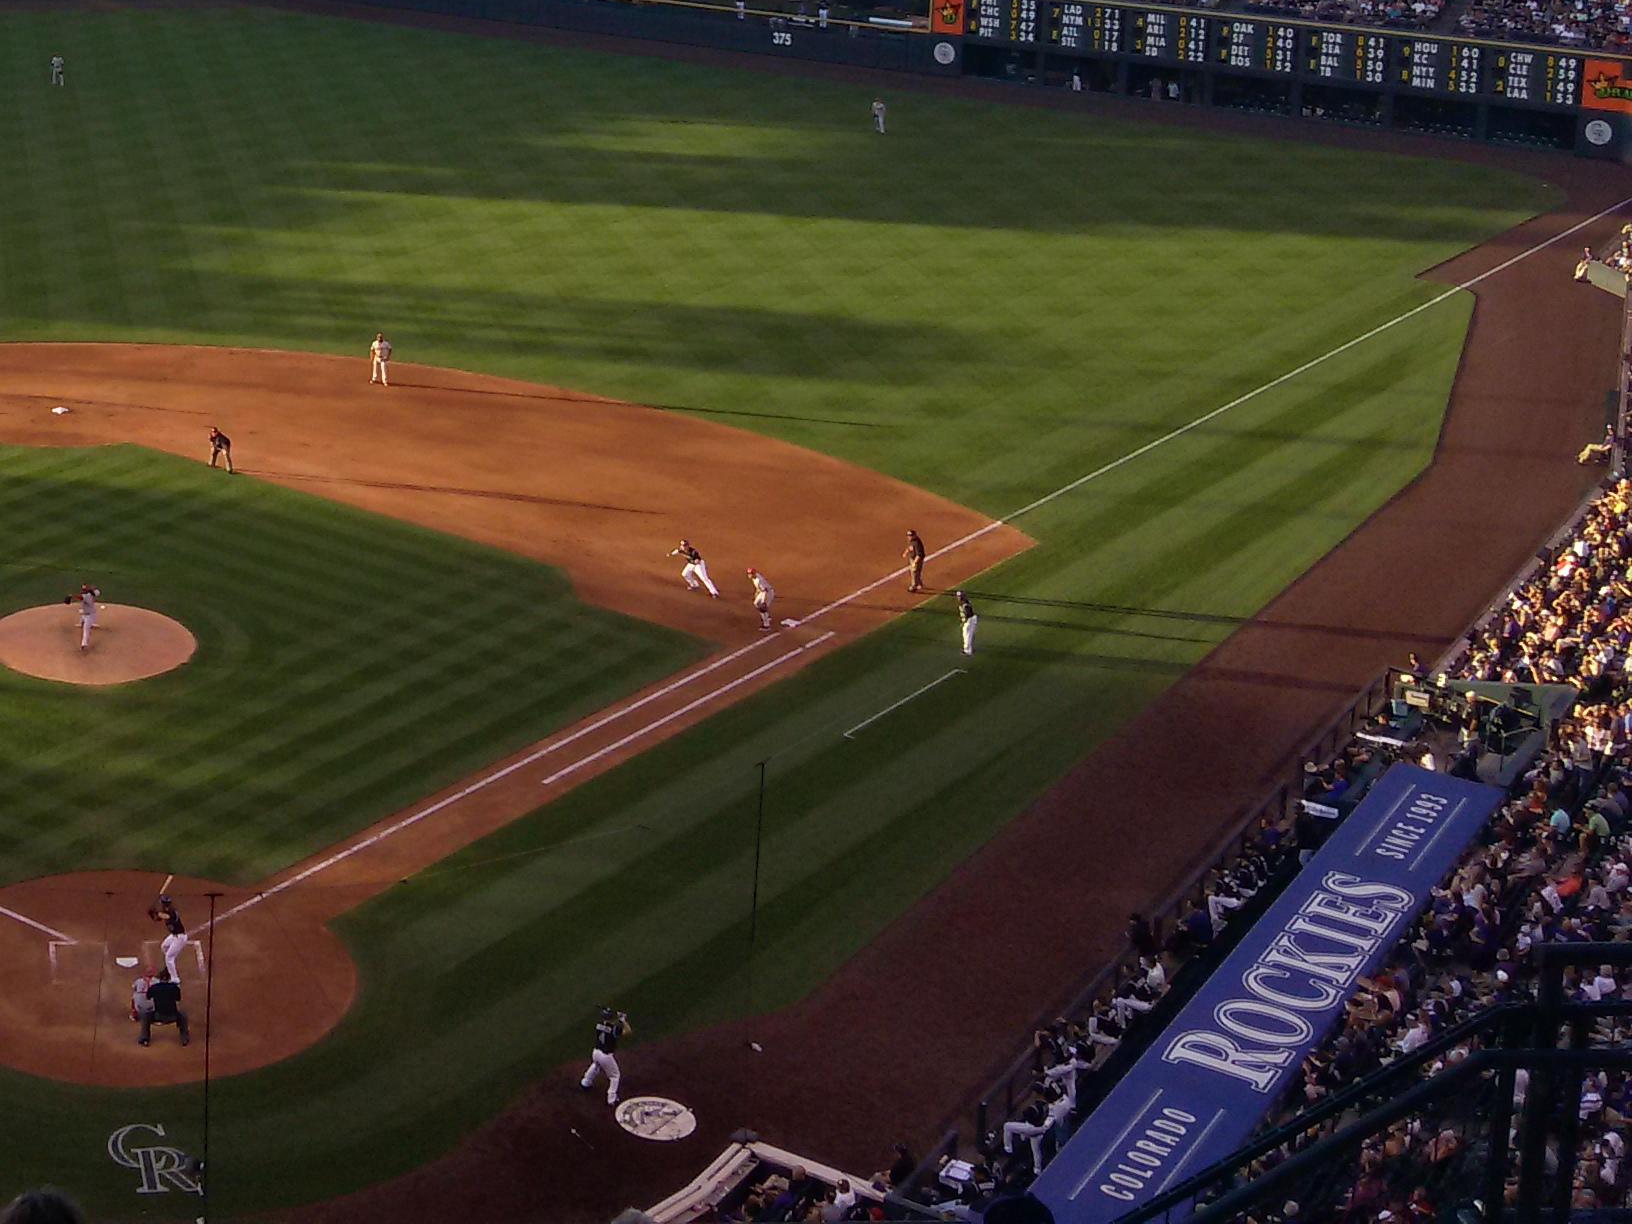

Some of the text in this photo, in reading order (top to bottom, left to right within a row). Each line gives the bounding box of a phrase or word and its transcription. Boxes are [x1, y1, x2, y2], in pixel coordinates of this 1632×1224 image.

[980, 6, 999, 17] CHC
[1064, 4, 1083, 15] LAD
[980, 17, 1000, 28] WSH
[1062, 14, 1083, 26] NYM
[1147, 13, 1166, 25] MIL
[979, 27, 992, 38] PIT
[1062, 26, 1078, 37] ATL
[1146, 24, 1164, 34] ARI
[1233, 22, 1254, 34] OAK
[772, 31, 793, 46] 375
[1061, 37, 1077, 48] STL
[1146, 35, 1166, 47] MIA
[1232, 34, 1244, 44] SF
[1322, 32, 1342, 44] TOR
[1145, 47, 1158, 57] SD
[1231, 45, 1249, 56] DET
[1321, 44, 1340, 55] SEA
[1414, 42, 1438, 54] HOU
[1230, 56, 1251, 67] BOS
[1320, 55, 1339, 67] BAL
[1414, 54, 1428, 64] KC
[1510, 52, 1534, 64] CHW
[1320, 66, 1332, 77] TB
[1412, 66, 1435, 77] NYY
[1509, 64, 1528, 75] CLE
[1412, 77, 1435, 89] MIN
[1508, 76, 1527, 88] TEX
[1507, 88, 1528, 100] LAA
[1374, 792, 1449, 861] SINCE 1993
[1161, 870, 1415, 1094] ROCKIES
[1099, 1105, 1197, 1202] COLORADO
